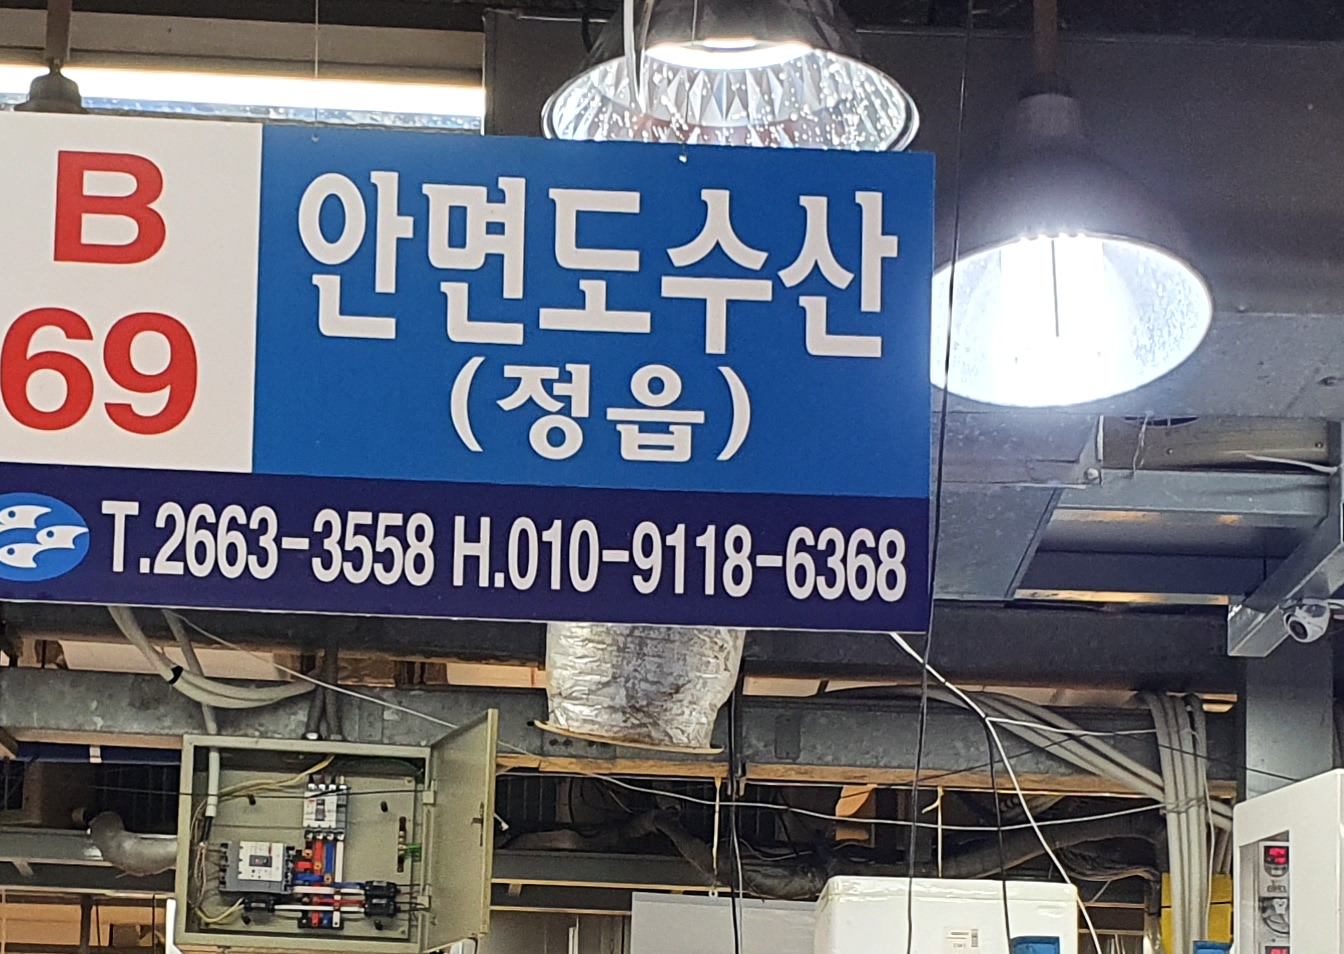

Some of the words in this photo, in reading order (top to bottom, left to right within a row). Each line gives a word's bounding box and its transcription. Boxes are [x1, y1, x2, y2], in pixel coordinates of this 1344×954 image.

[53, 149, 168, 264] B
[297, 168, 899, 358] 안면도수산
[449, 355, 752, 463] (정읍)
[101, 498, 436, 588] T.2663-3558
[452, 517, 907, 603] H.010-9118-6368
